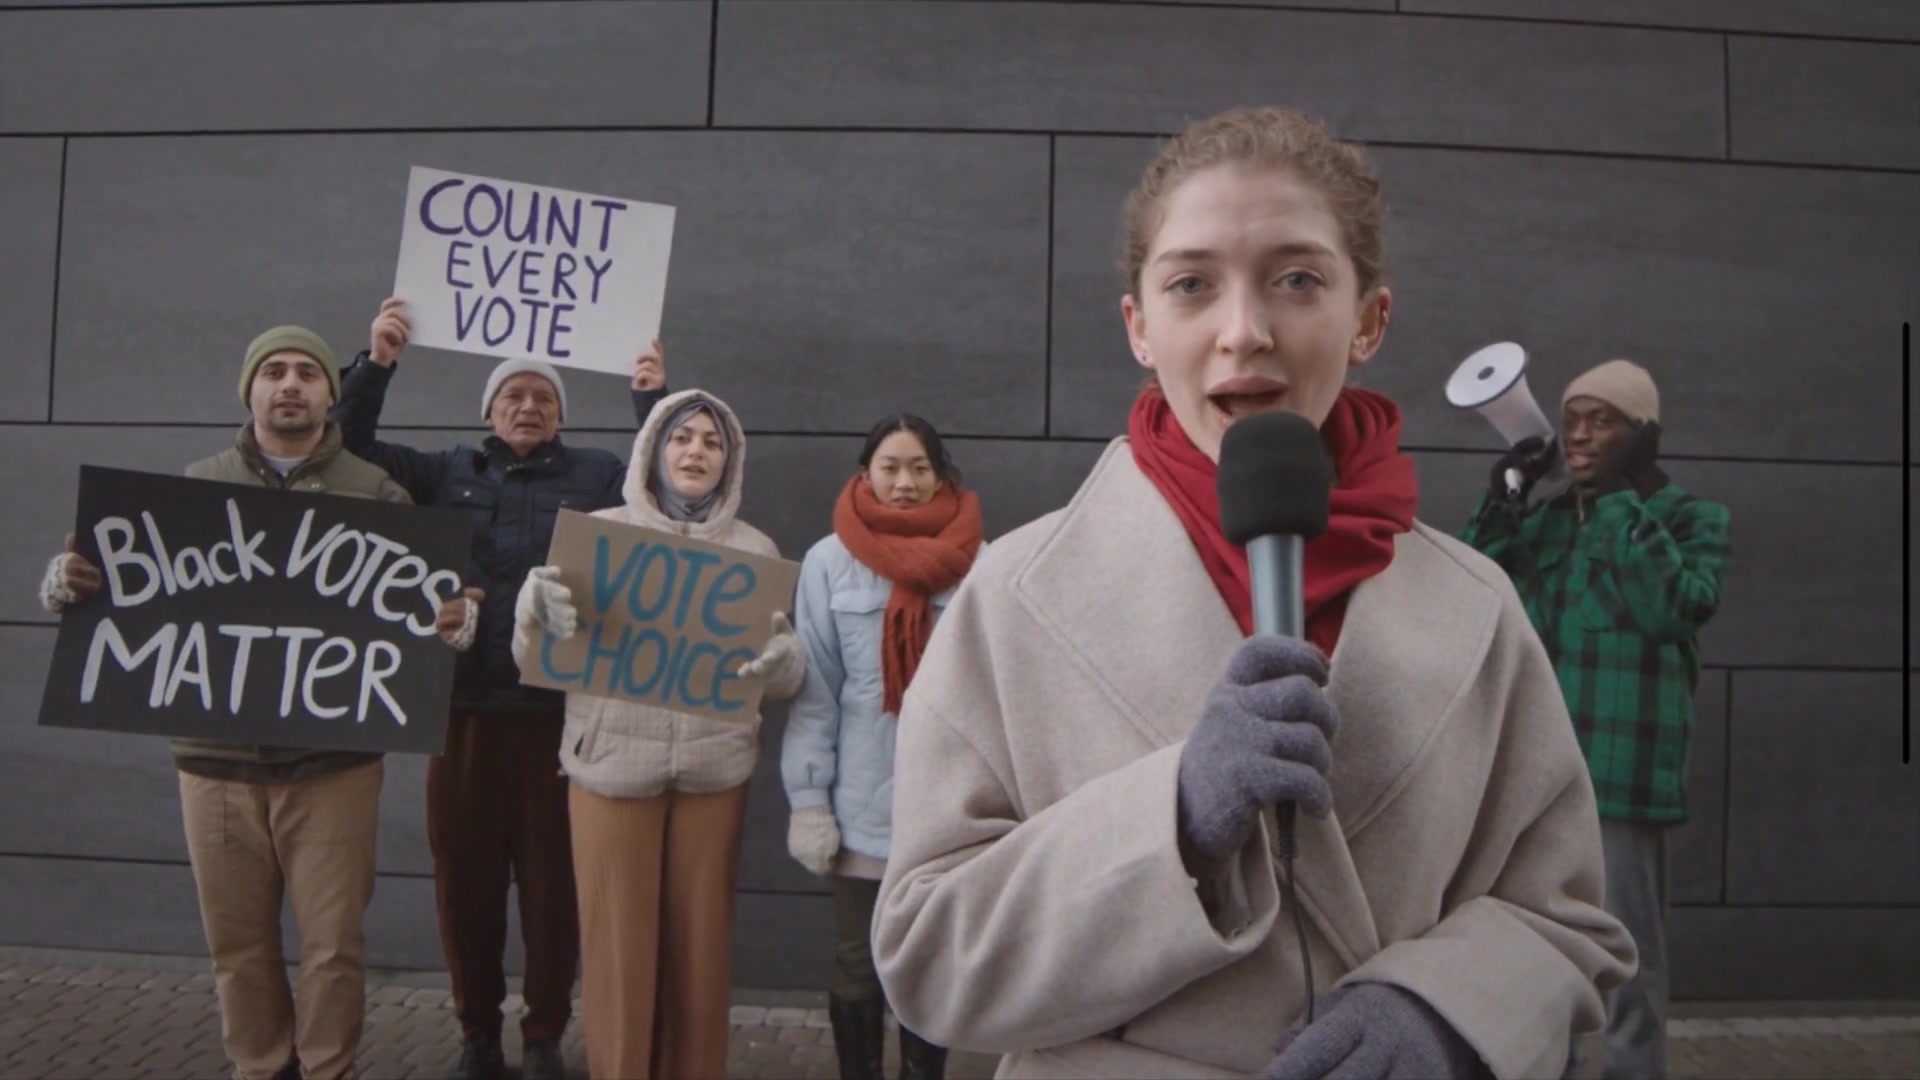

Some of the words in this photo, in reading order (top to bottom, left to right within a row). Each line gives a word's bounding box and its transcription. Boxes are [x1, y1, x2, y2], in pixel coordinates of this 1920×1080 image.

[419, 178, 628, 252] COUNT
[446, 240, 613, 304] EVERY
[455, 290, 576, 358] VOTE
[94, 498, 275, 607] Black
